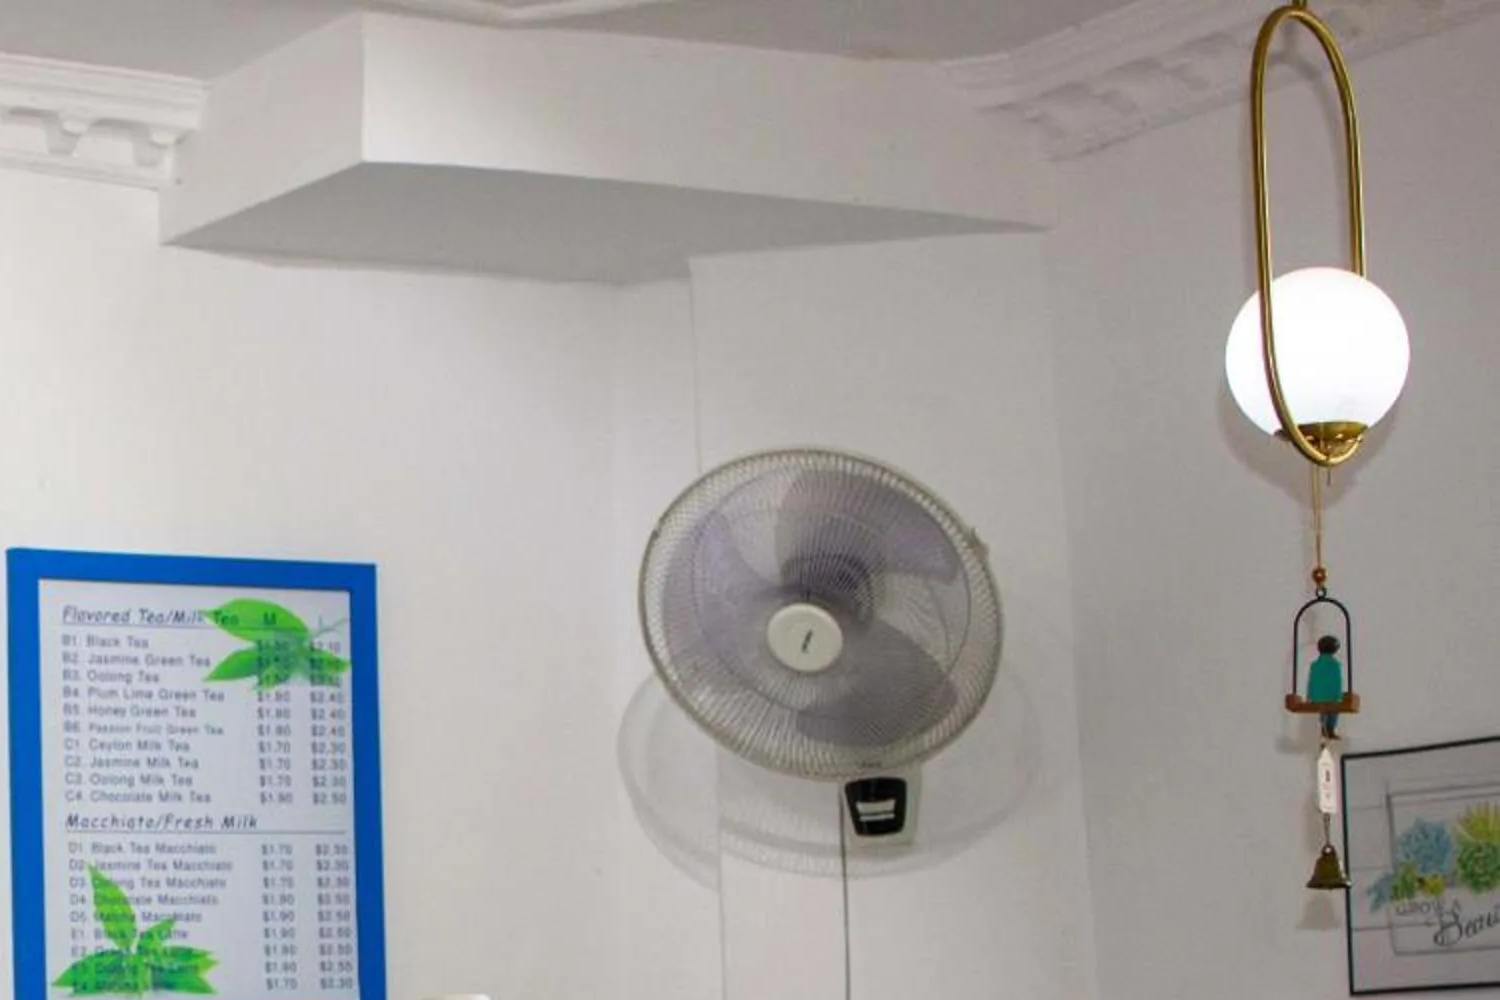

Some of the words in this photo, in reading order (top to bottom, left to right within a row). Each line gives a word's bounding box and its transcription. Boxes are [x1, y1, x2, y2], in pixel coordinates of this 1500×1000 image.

[63, 606, 135, 625] Flavored
[139, 670, 160, 683] Tea
[178, 756, 199, 770] Tea
[172, 774, 193, 787] Tea
[190, 790, 212, 804] Tea
[220, 814, 259, 830] Milk
